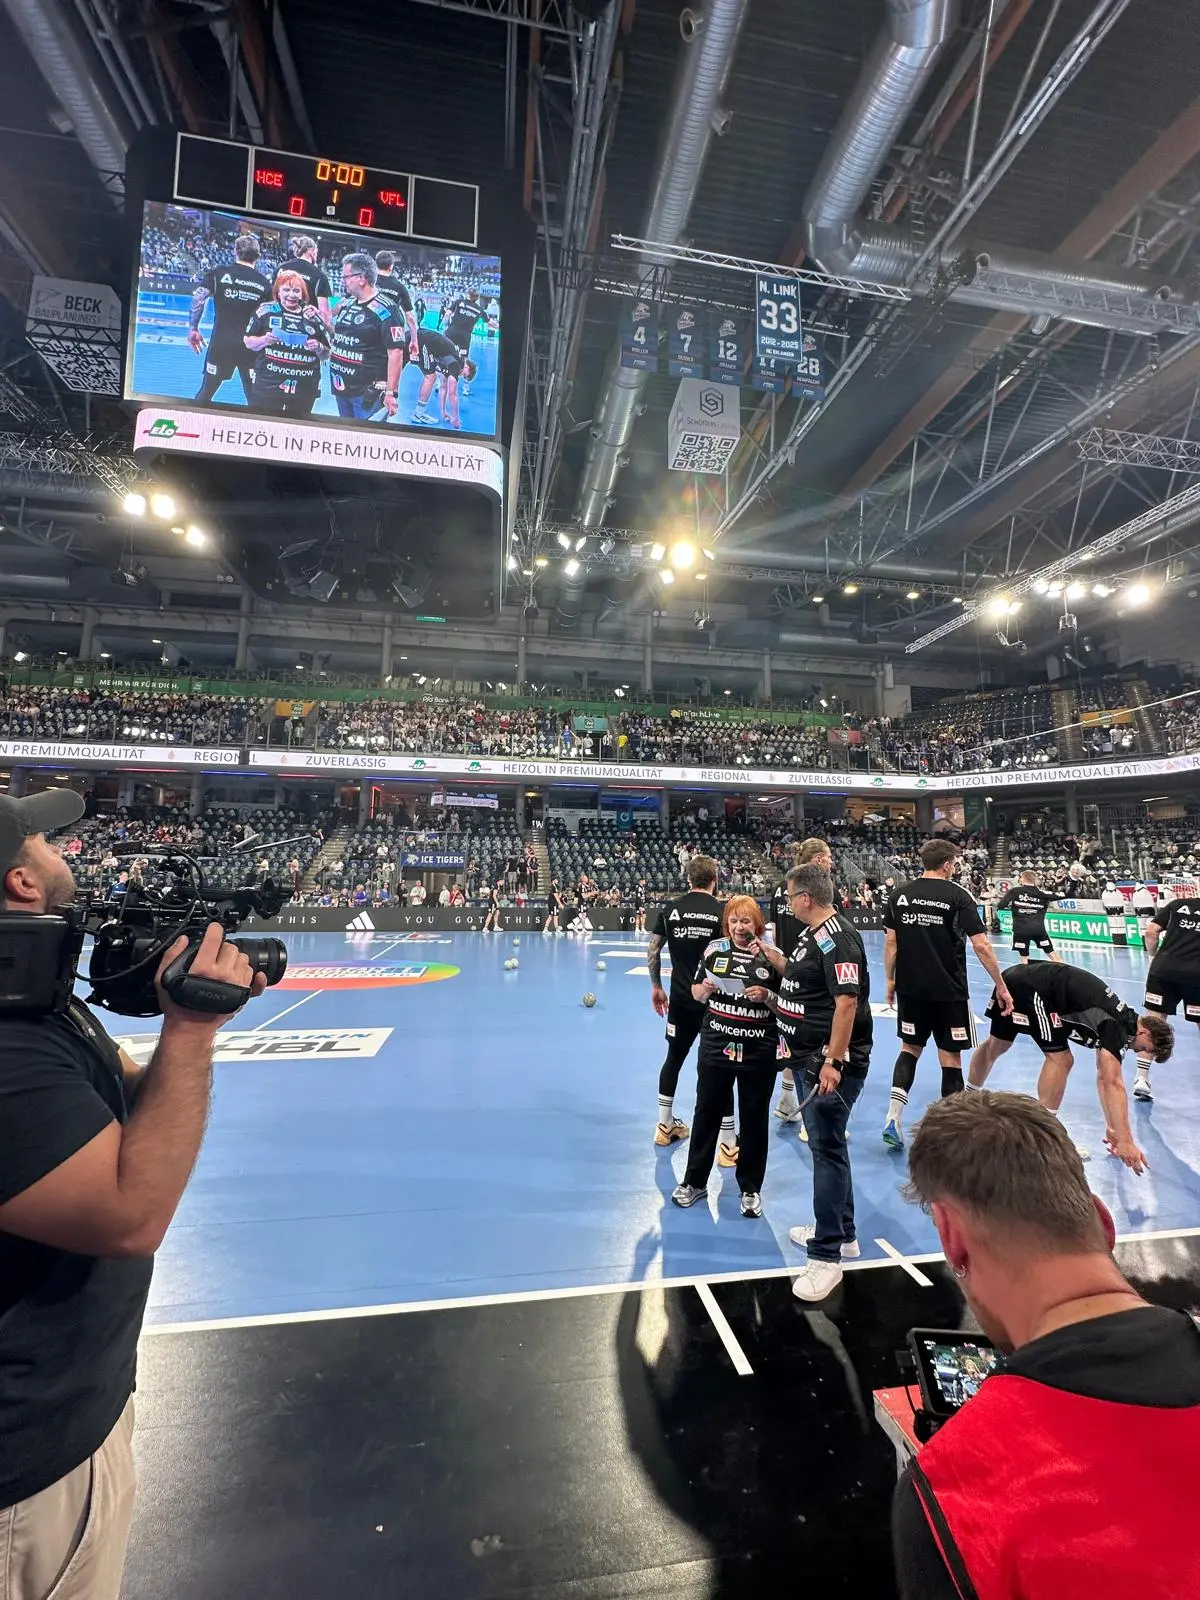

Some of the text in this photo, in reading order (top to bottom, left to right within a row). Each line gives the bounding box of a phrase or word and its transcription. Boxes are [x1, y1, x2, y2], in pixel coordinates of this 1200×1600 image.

[256, 170, 283, 187] HCE
[317, 162, 364, 186] 0:00
[290, 197, 304, 216] 0
[380, 191, 405, 206] VFL
[360, 208, 372, 227] 0
[773, 284, 797, 298] LINK
[64, 295, 102, 314] BECK
[760, 298, 798, 334] 33
[634, 326, 646, 344] 4
[680, 334, 692, 352] 7
[718, 340, 738, 360] 12
[266, 362, 314, 376] devicenow
[797, 356, 820, 376] 28
[279, 380, 296, 394] 41
[212, 429, 484, 472] HEIZÖL IN PREMIUMQUALITÄT
[13, 744, 146, 760] PREMIUMQUALITÄT
[306, 754, 386, 768] ZUVERLÄSSIG
[503, 763, 663, 780] HEIZÖL IN PREMIUMQUALITÄT
[701, 770, 752, 782] REGIONAL
[990, 774, 1004, 784] IN
[1007, 764, 1140, 784] PREMIUMQUALITÄT
[422, 856, 464, 864] ICE TIGERS
[912, 898, 950, 910] AICHINGER
[1057, 900, 1076, 909] DKB
[278, 916, 318, 924] THIS
[405, 916, 540, 924] YOU GOT THIS
[682, 912, 719, 922] AICHINGER
[1086, 922, 1108, 936] WI
[710, 1019, 765, 1037] devicenow
[255, 1032, 372, 1041] DAIKIN
[723, 1042, 743, 1062] 41
